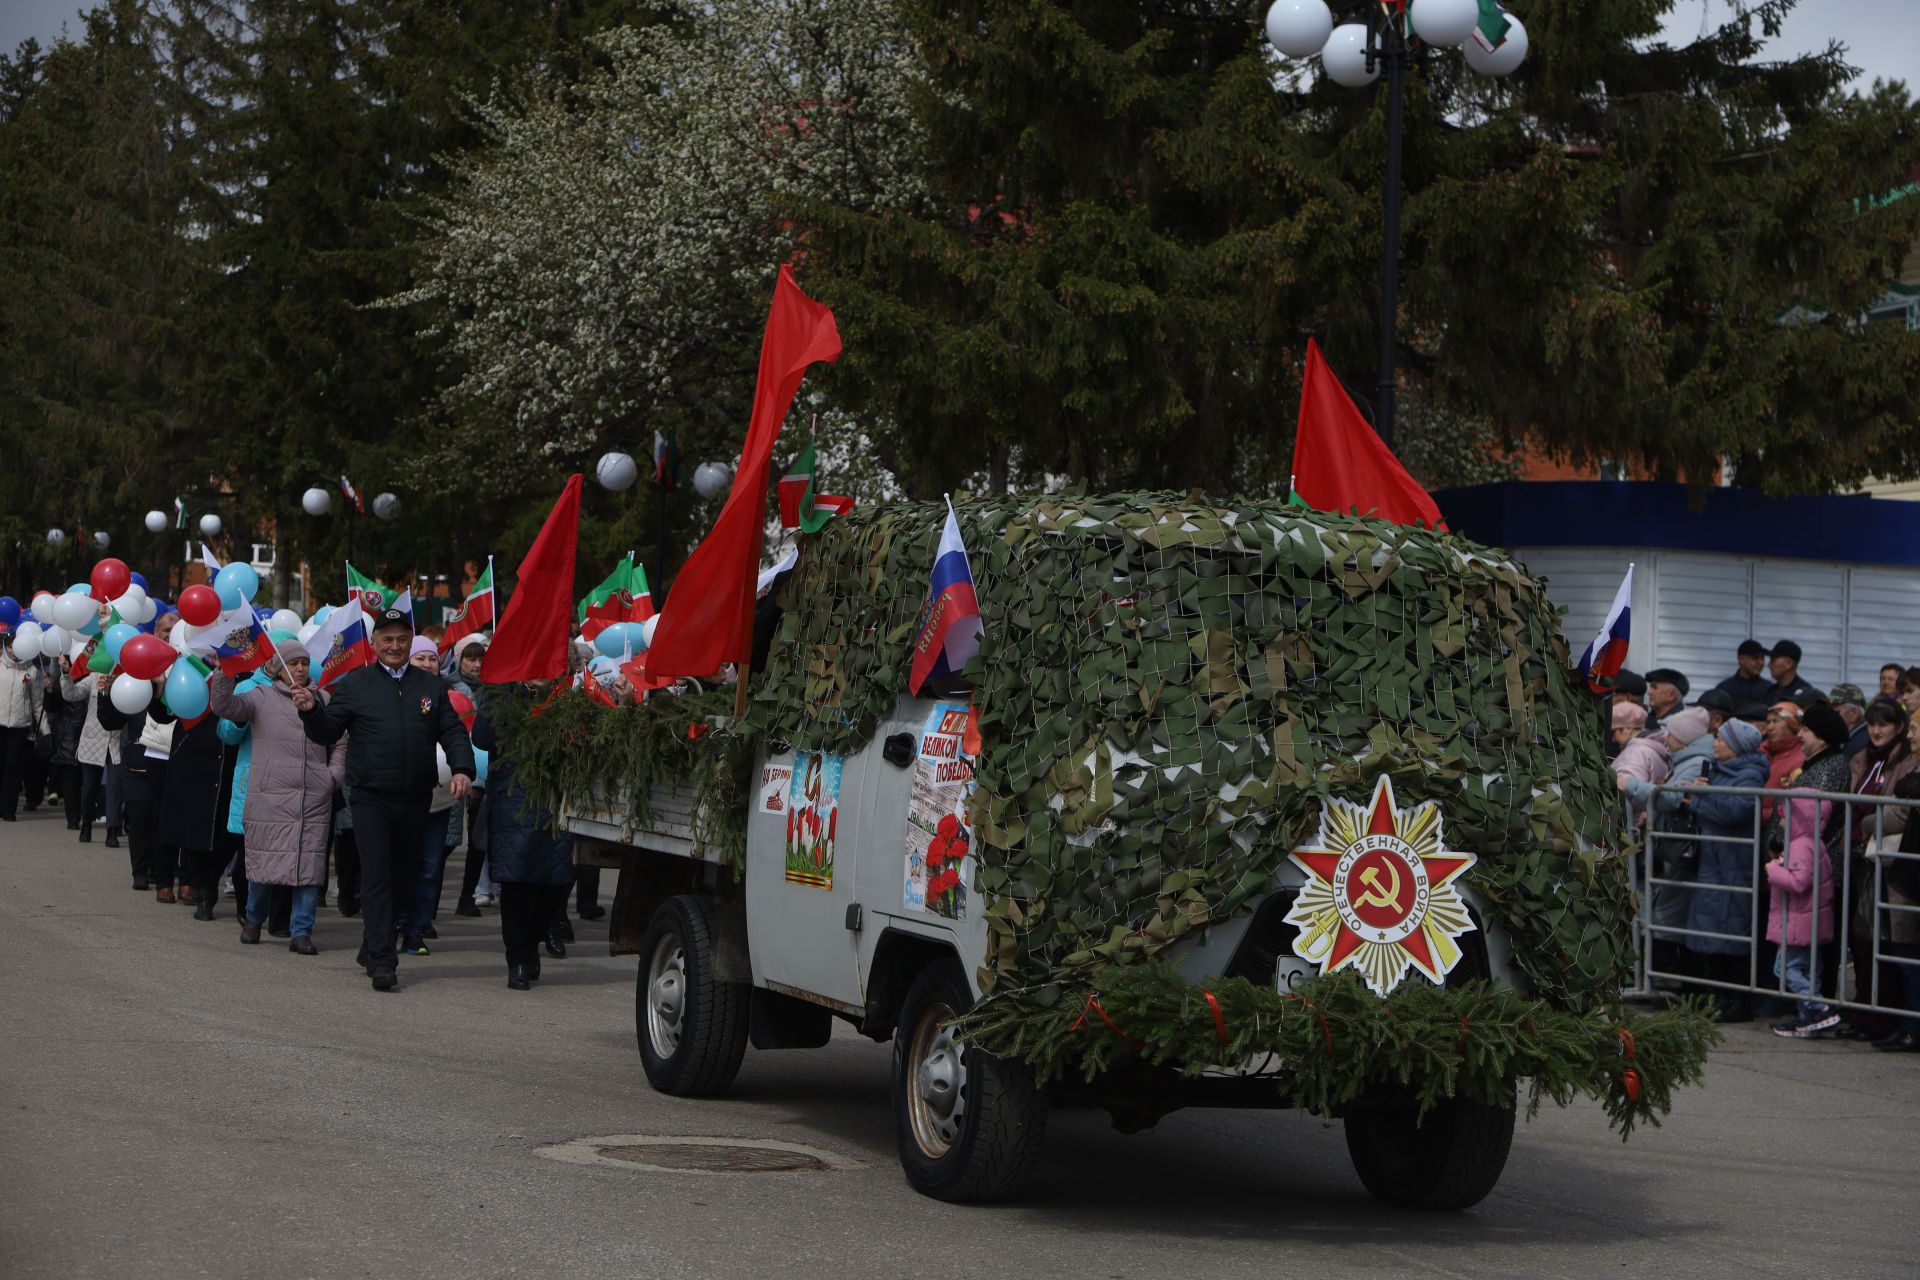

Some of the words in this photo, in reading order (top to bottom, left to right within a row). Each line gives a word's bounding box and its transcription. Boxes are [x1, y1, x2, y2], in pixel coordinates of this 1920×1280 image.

[921, 735, 958, 759] ВЕЛИКОЙ
[1334, 836, 1420, 931] ОТЕЧЕСТВЕННАЯ
[1399, 875, 1428, 935] ВОЙНА
